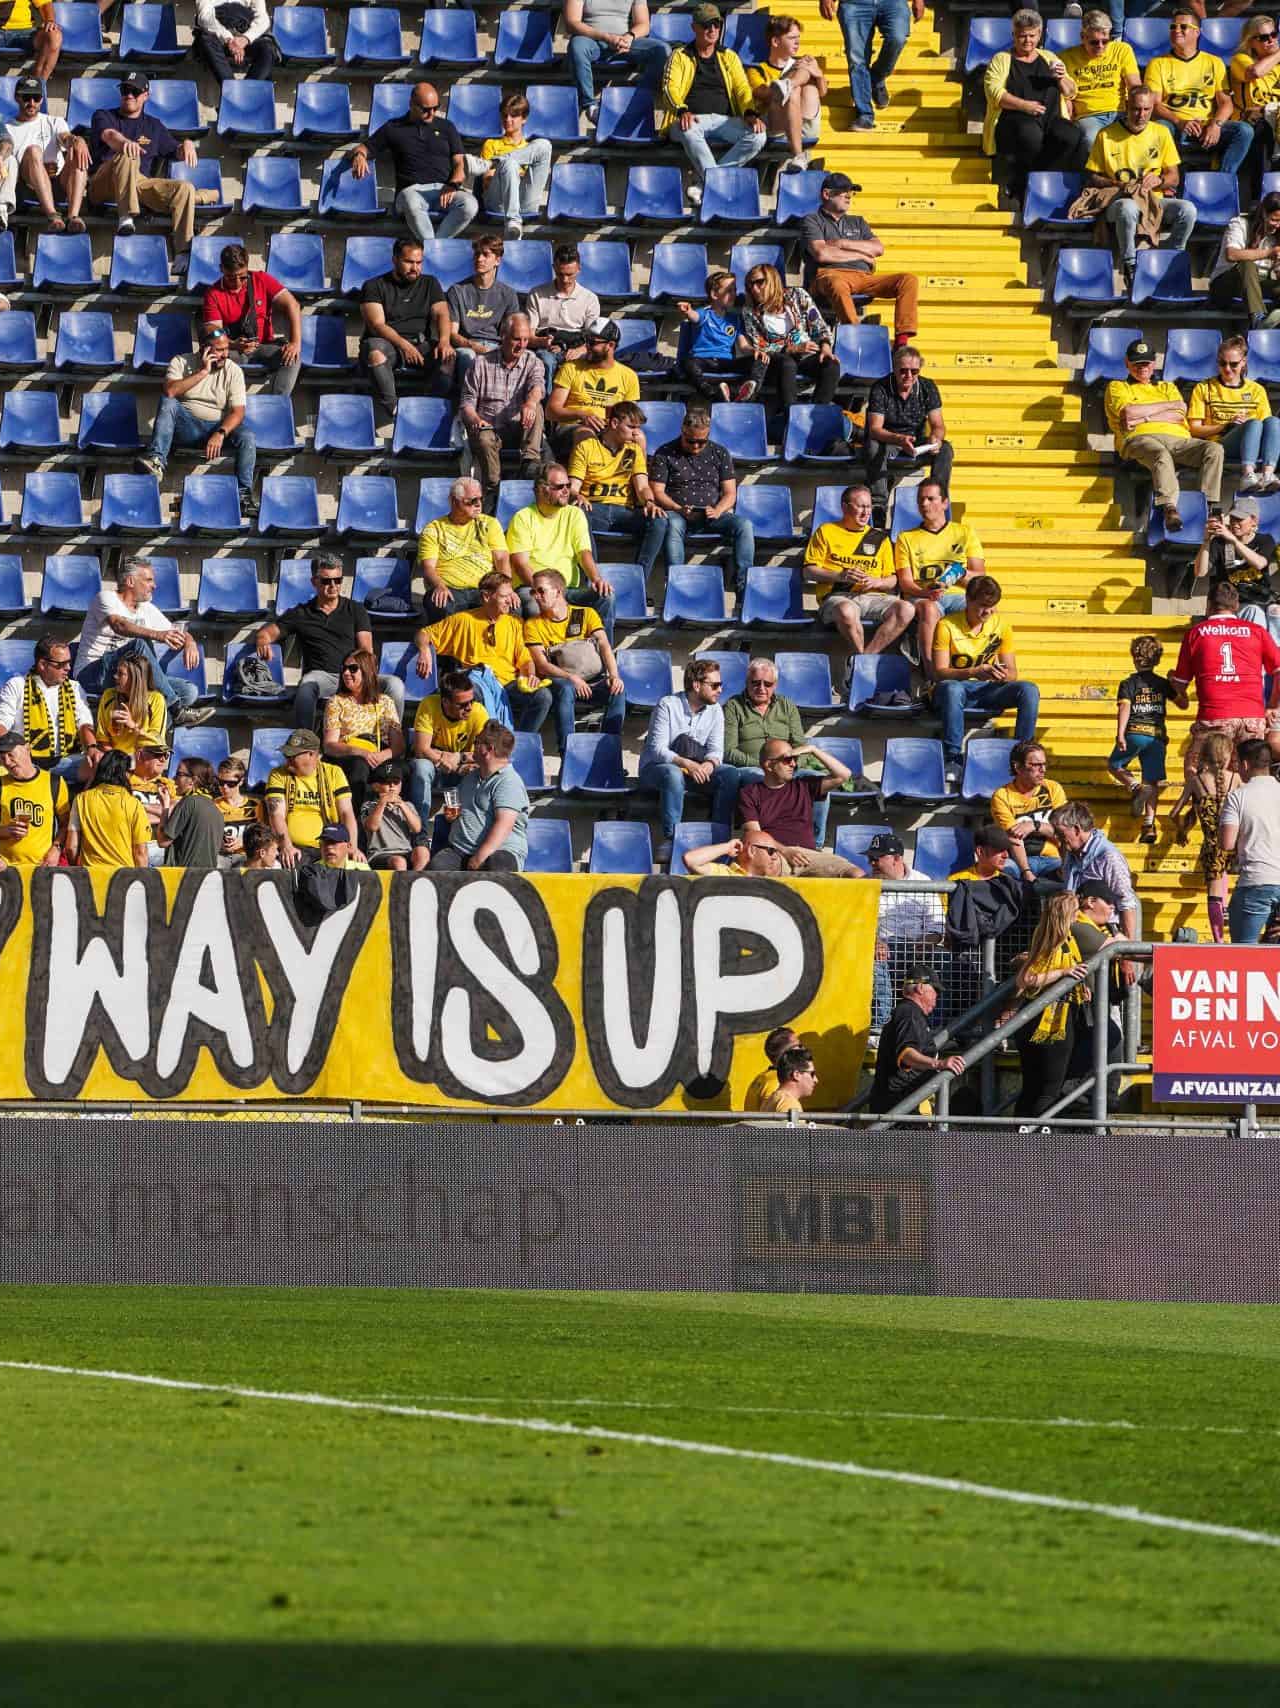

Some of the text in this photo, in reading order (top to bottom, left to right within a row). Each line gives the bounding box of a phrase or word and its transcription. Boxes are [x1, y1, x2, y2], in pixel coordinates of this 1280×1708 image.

[1198, 625, 1251, 637] Welkom
[1220, 642, 1236, 675] 1
[31, 868, 374, 1092] WAY
[398, 872, 567, 1102] IS
[594, 880, 815, 1099] UP
[1170, 969, 1238, 993] VAN
[1171, 997, 1238, 1021] DEN
[1171, 1029, 1236, 1049] AFVAL
[766, 1193, 900, 1244] MBI
